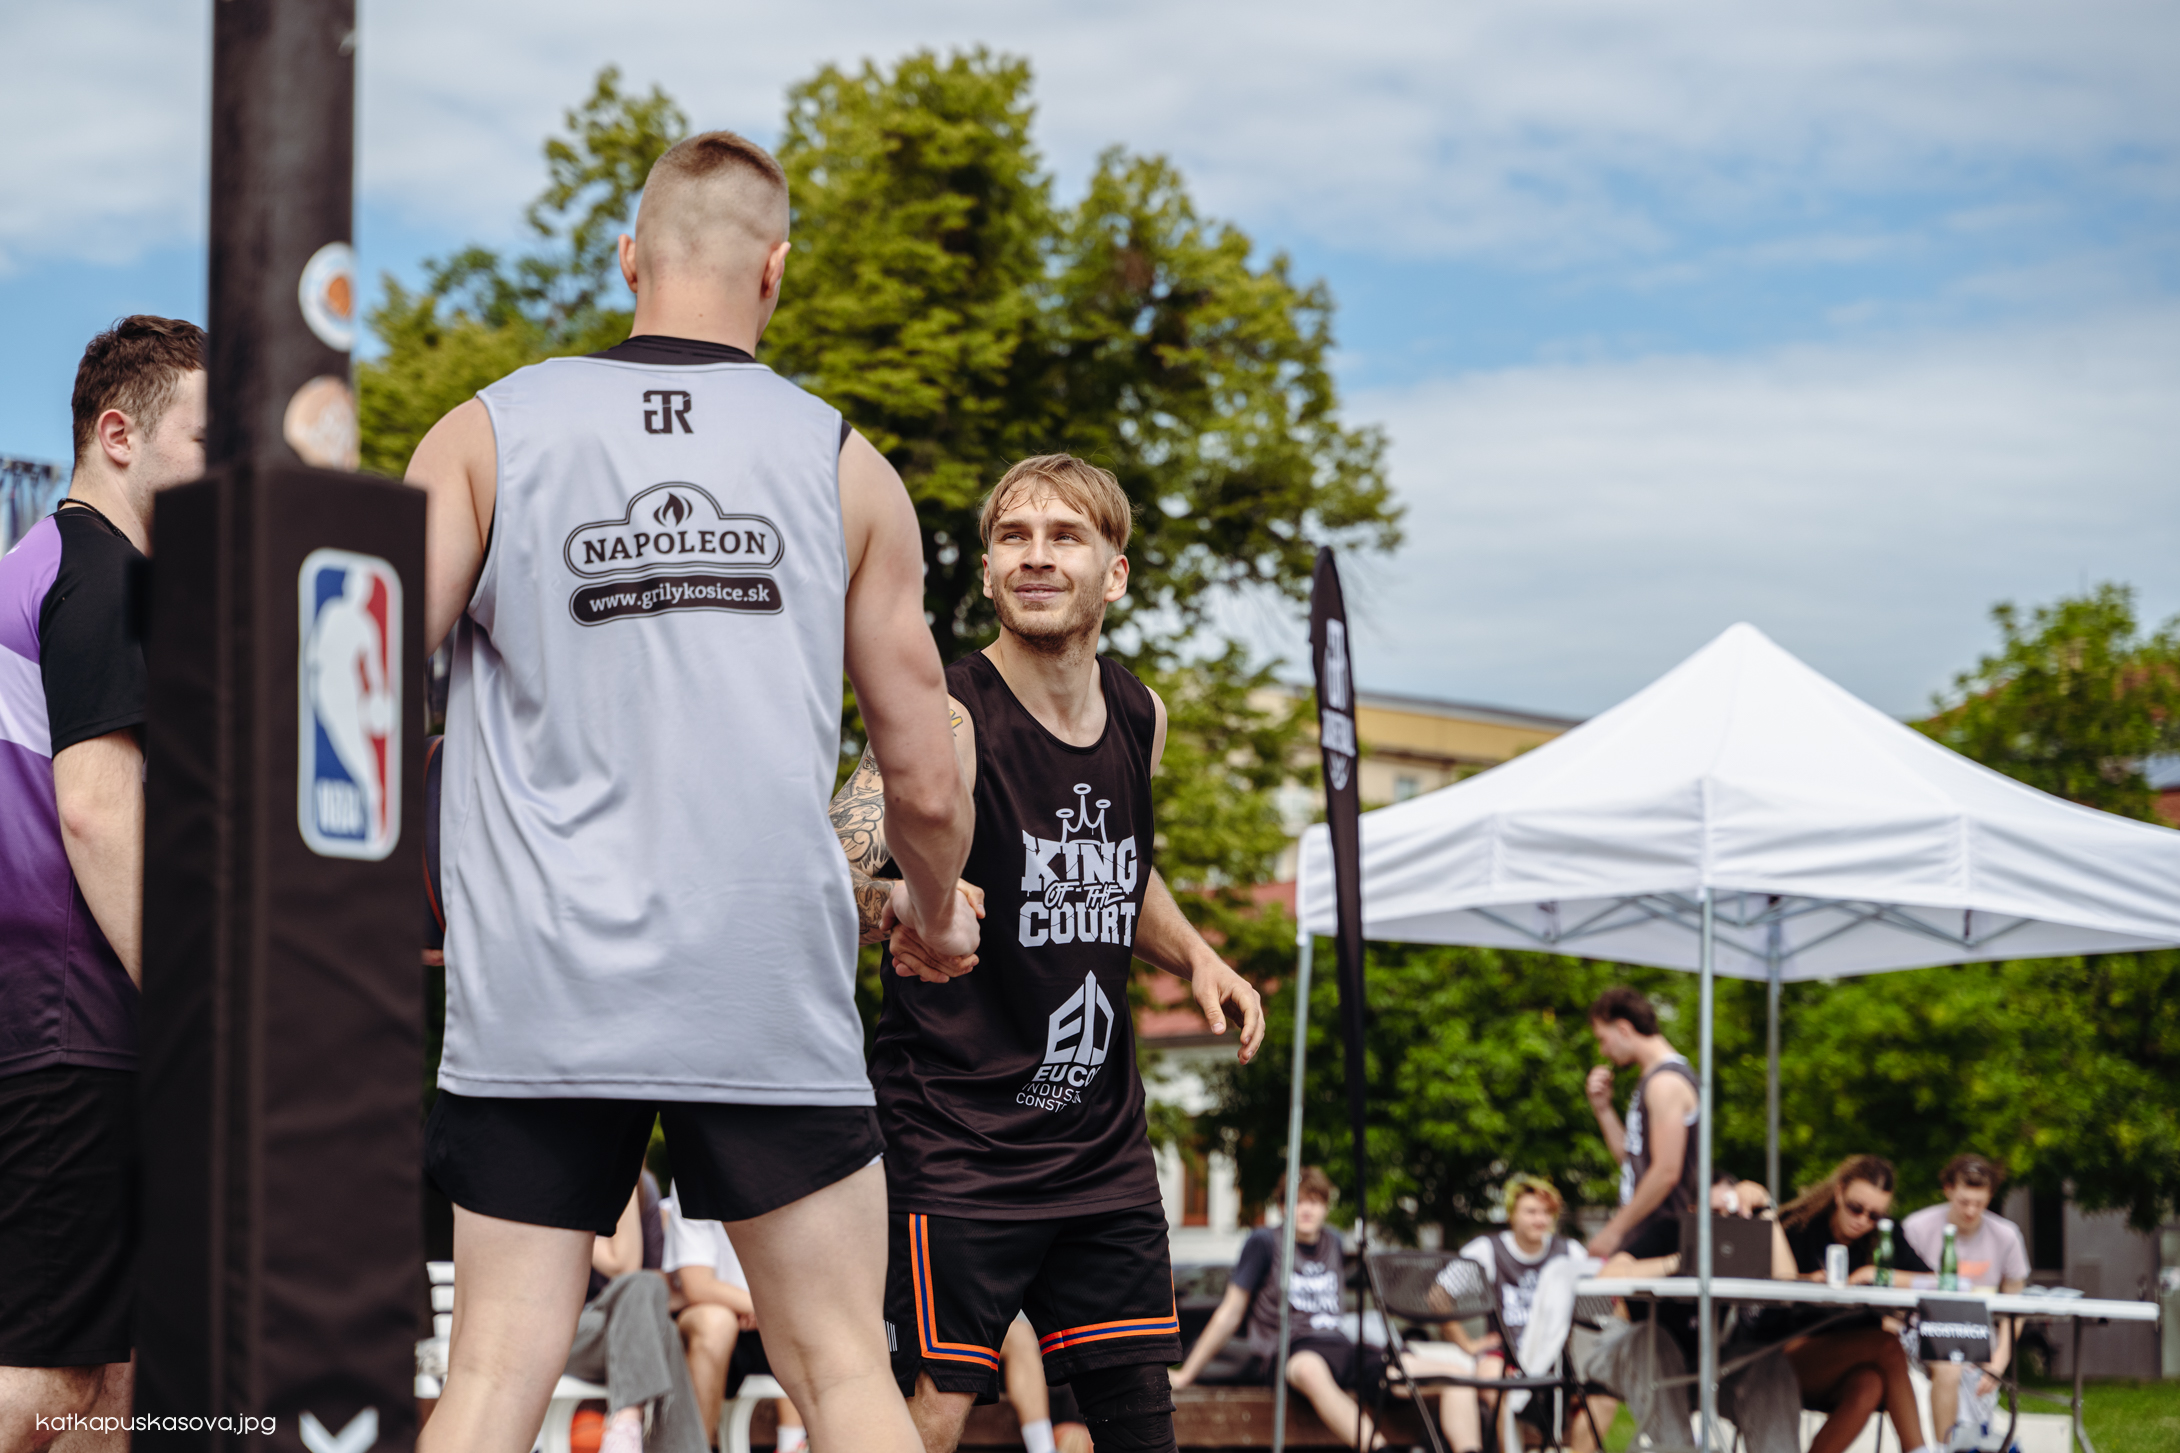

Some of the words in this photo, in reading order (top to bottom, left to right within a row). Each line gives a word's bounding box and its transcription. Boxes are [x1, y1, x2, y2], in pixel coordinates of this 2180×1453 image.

[582, 530, 766, 565] NAPOLEON
[589, 582, 771, 613] www.grilykosice.sk
[1020, 829, 1138, 897] KING
[1044, 881, 1080, 908] OF
[1083, 884, 1126, 908] THE
[1018, 901, 1136, 948] COURT
[1016, 1092, 1068, 1113] CONST
